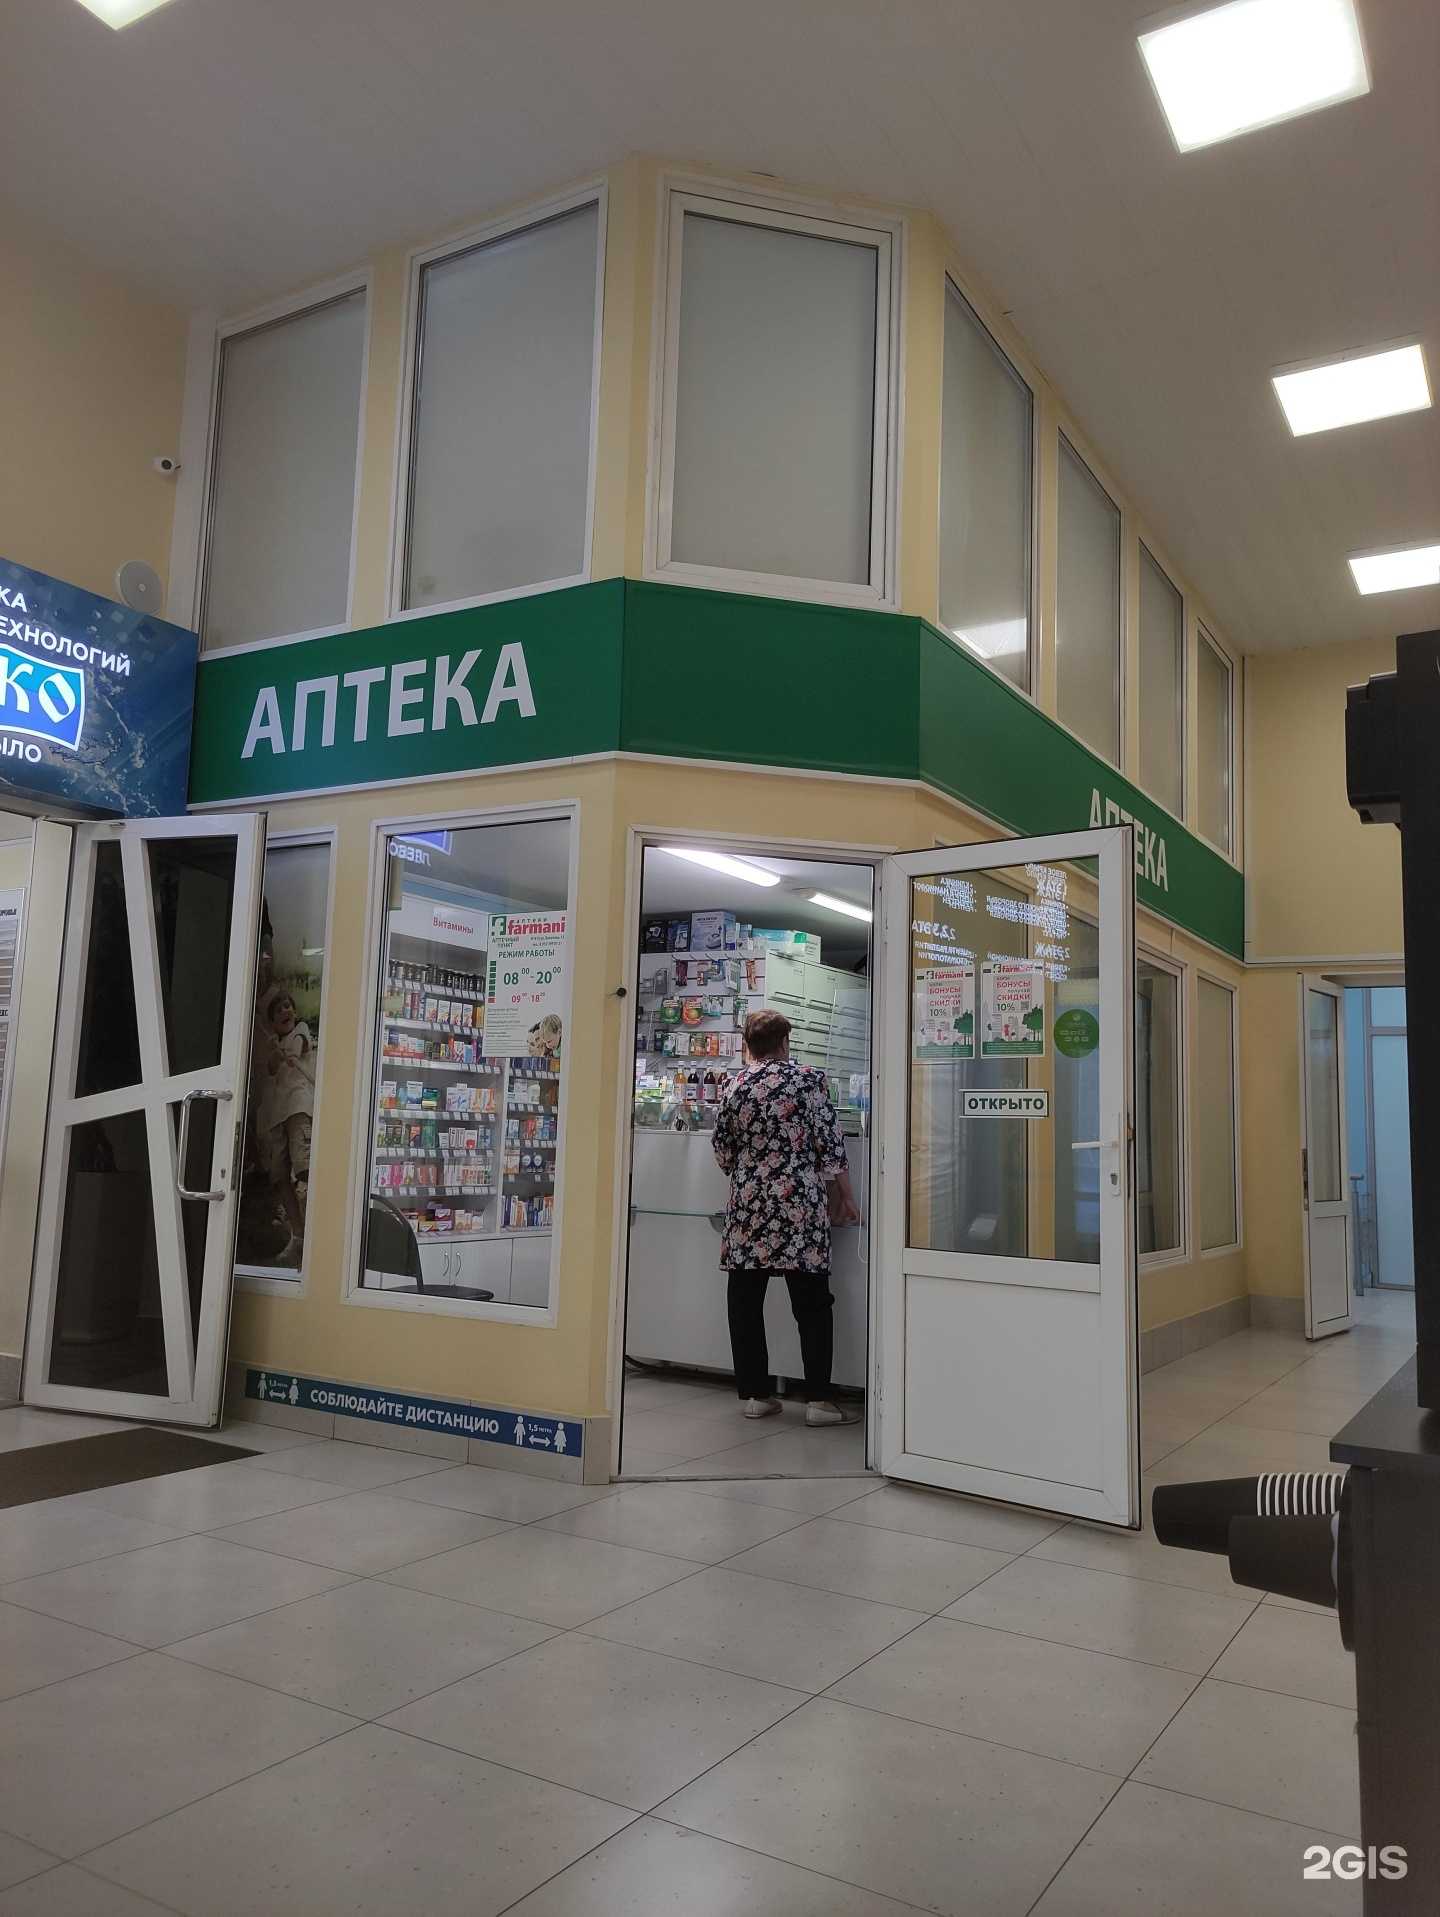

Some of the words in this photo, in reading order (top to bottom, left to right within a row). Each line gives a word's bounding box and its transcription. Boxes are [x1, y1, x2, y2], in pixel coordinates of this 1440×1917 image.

[241, 641, 536, 759] АПТЕКА
[1089, 788, 1169, 892] АЕКА
[432, 916, 474, 935] Витамины
[508, 916, 565, 935] farmani
[498, 951, 524, 959] РЕЖИМ
[525, 949, 555, 958] РАБОТЫ
[503, 971, 519, 986] 08
[536, 970, 553, 985] 20
[996, 981, 1031, 989] БОНУСЫ
[929, 986, 961, 995] БОНУСЫ
[930, 1008, 947, 1017] 10%
[997, 1002, 1016, 1011] 10%
[968, 1098, 1044, 1110] ОТКРЫТО
[310, 1389, 403, 1418] СОБЛЮДАЙТЕ
[405, 1405, 500, 1434] ДИСТАНЦИЮ
